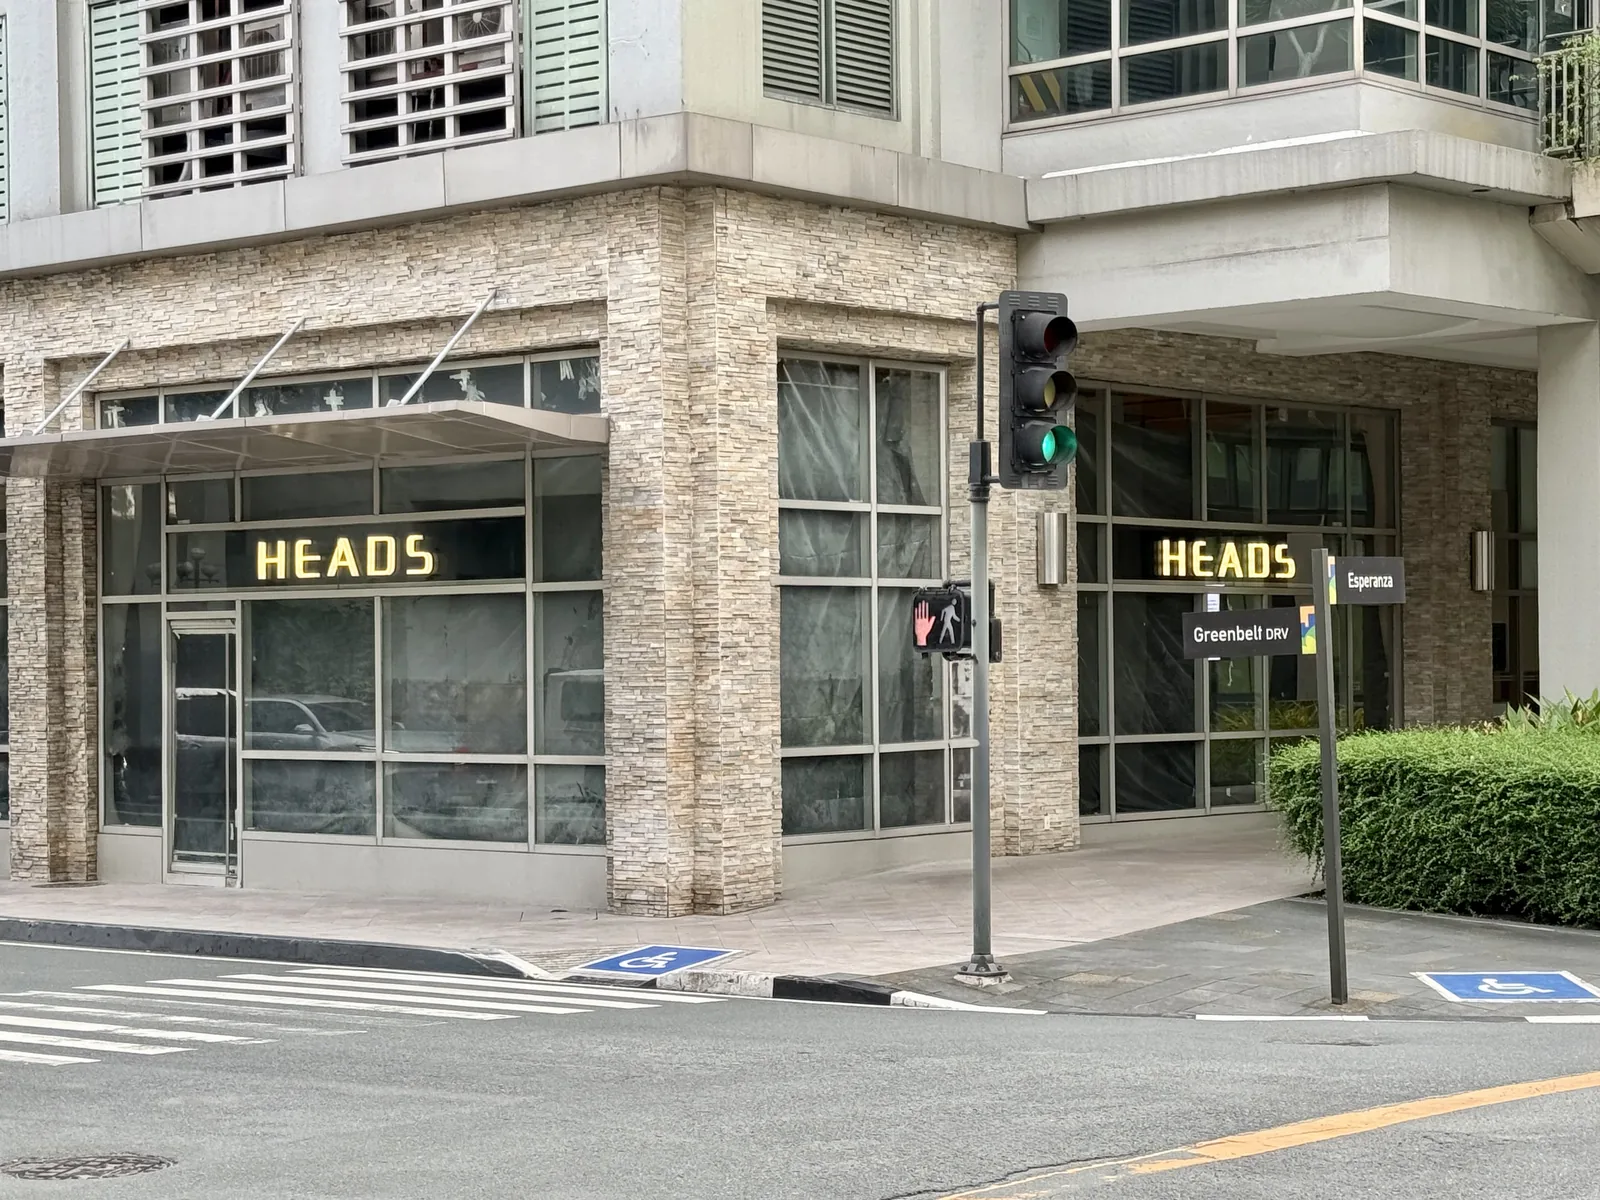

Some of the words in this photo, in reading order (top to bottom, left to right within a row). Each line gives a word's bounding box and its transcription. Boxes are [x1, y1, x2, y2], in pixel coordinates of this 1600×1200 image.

[257, 534, 434, 580] HEADS
[1161, 539, 1296, 578] HEADS
[1347, 571, 1394, 592] Esperanza
[1193, 625, 1263, 643] Greenbelt
[1266, 627, 1289, 641] DRV
